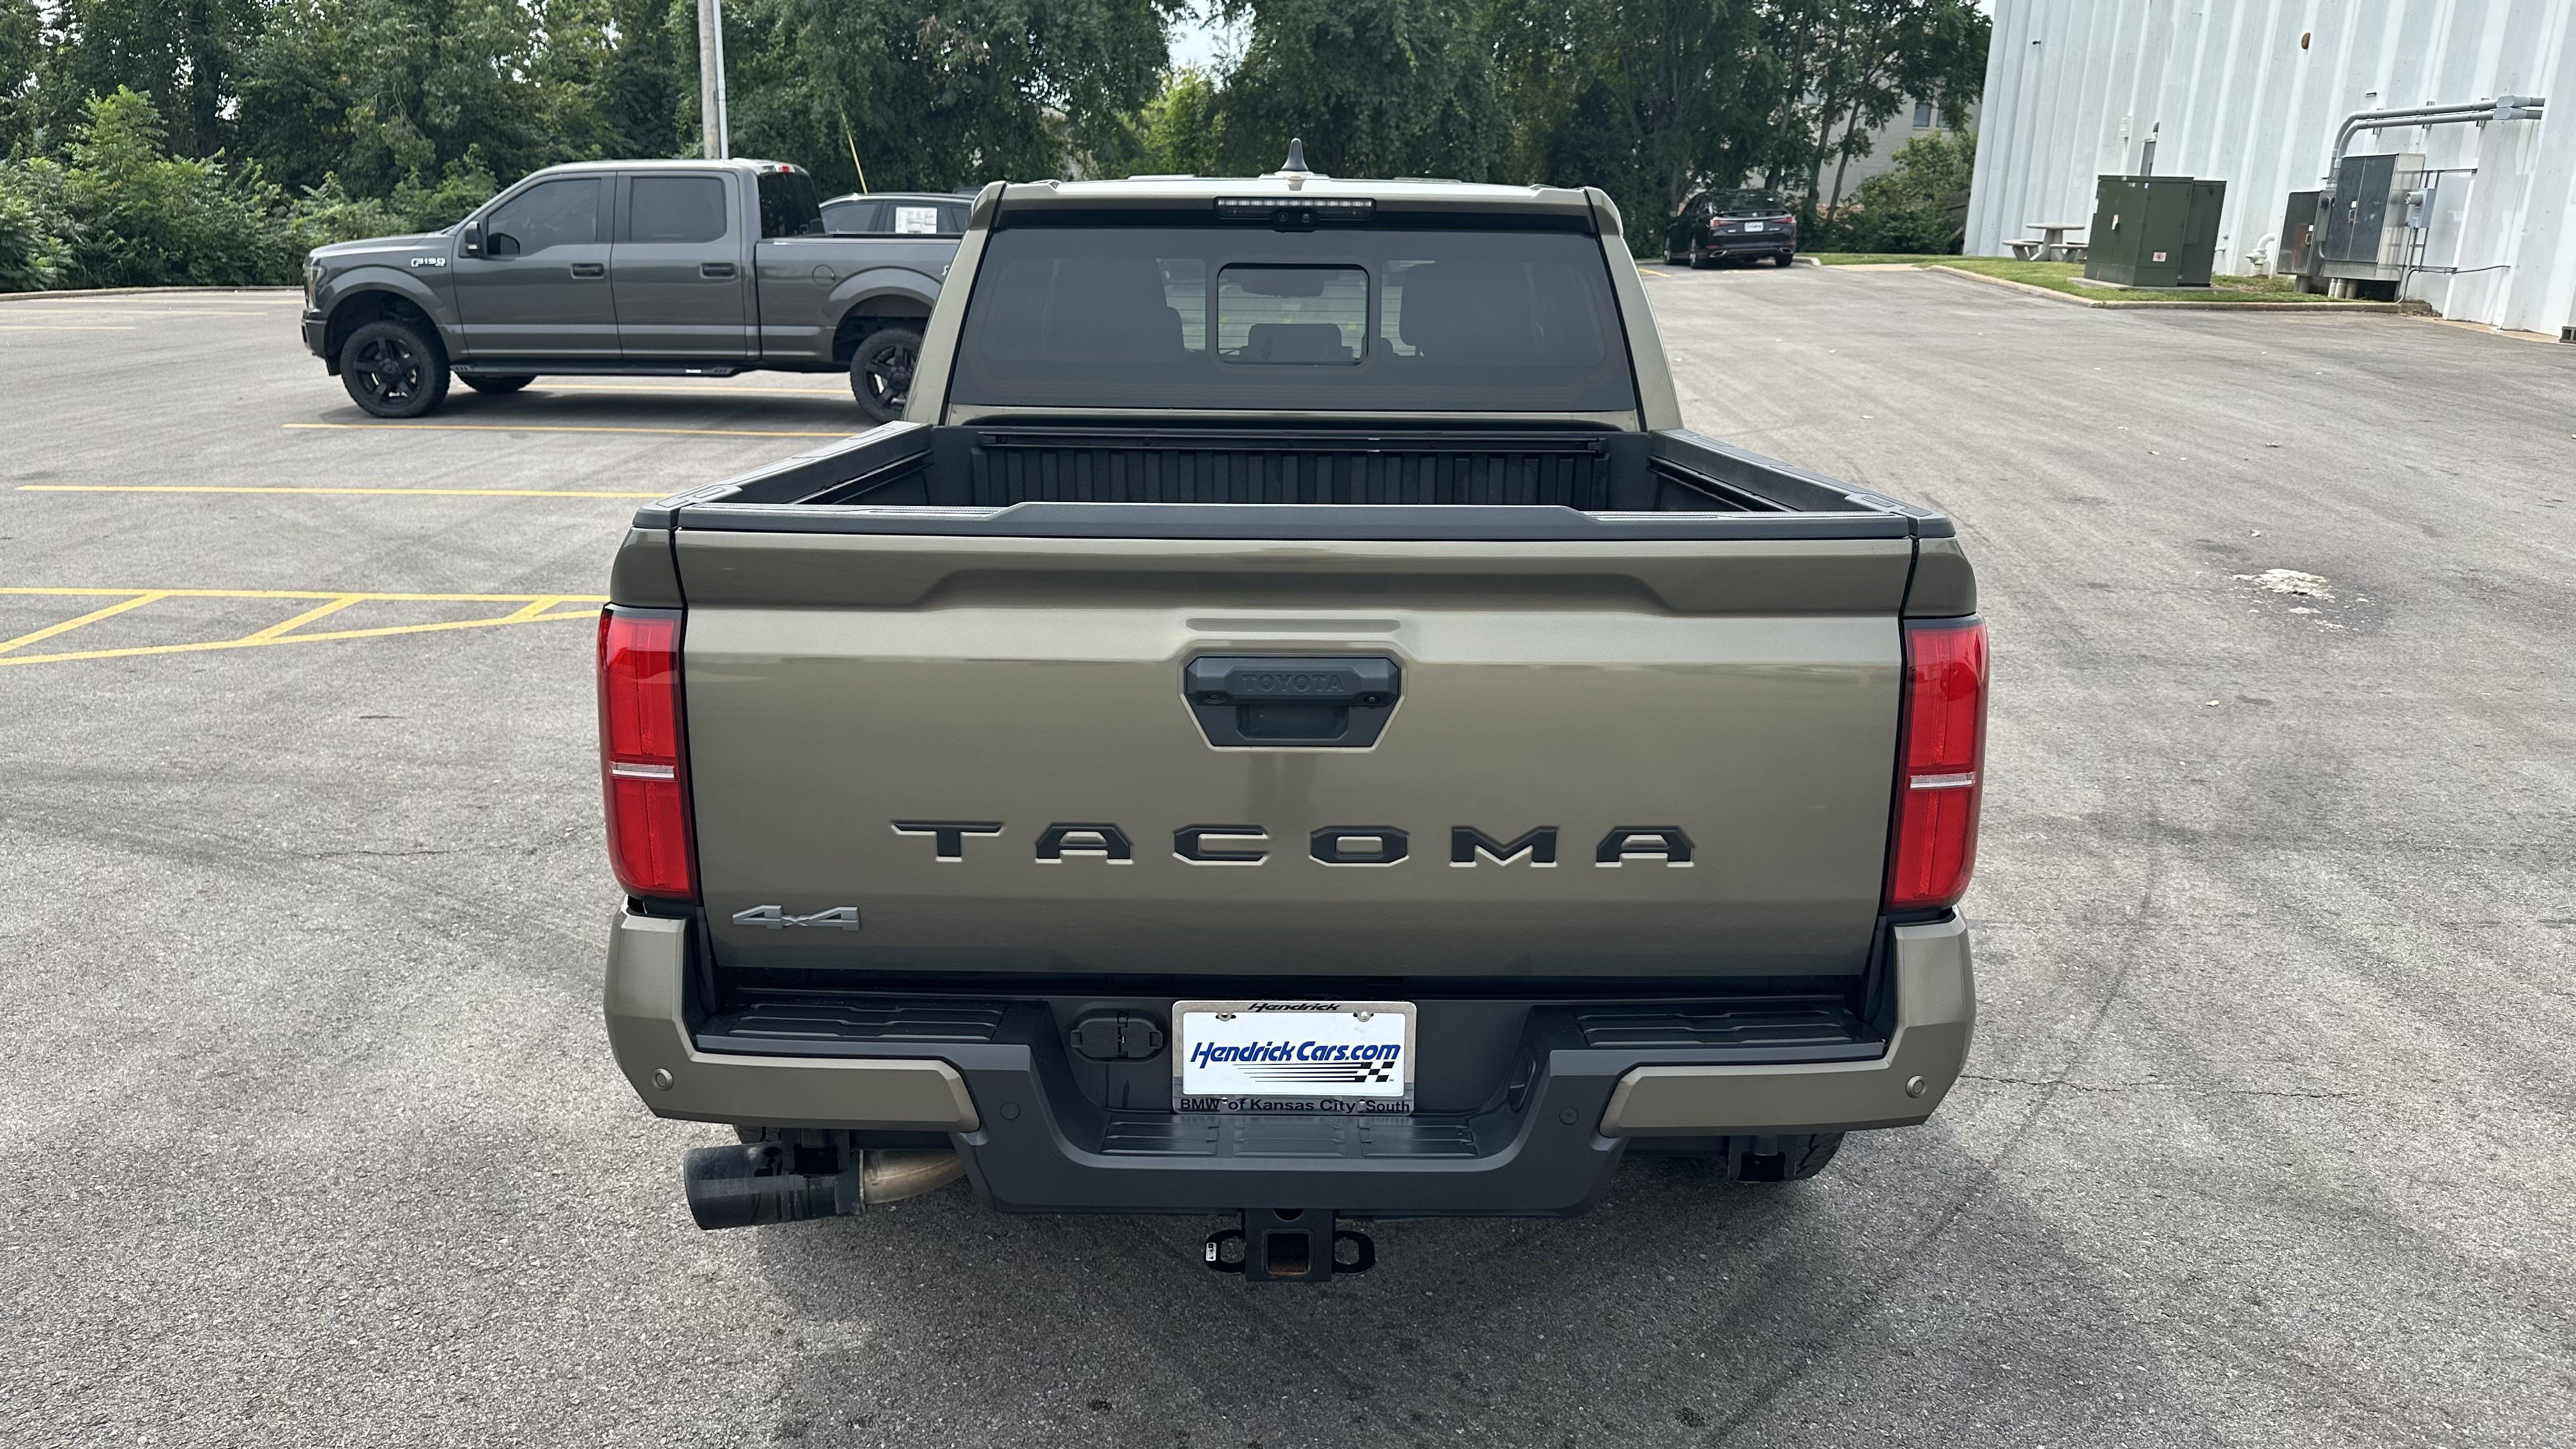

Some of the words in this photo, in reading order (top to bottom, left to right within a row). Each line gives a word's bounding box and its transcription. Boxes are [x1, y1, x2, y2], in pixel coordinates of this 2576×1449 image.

[1242, 674, 1344, 691] TOYOTA
[891, 822, 1696, 868] TACOMA
[1248, 1002, 1341, 1012] Hendrick
[1180, 1098, 1220, 1110] BMW
[1227, 1099, 1245, 1110] of
[1250, 1099, 1314, 1111] Kansas
[1319, 1099, 1356, 1114] City
[1365, 1100, 1409, 1114] South
